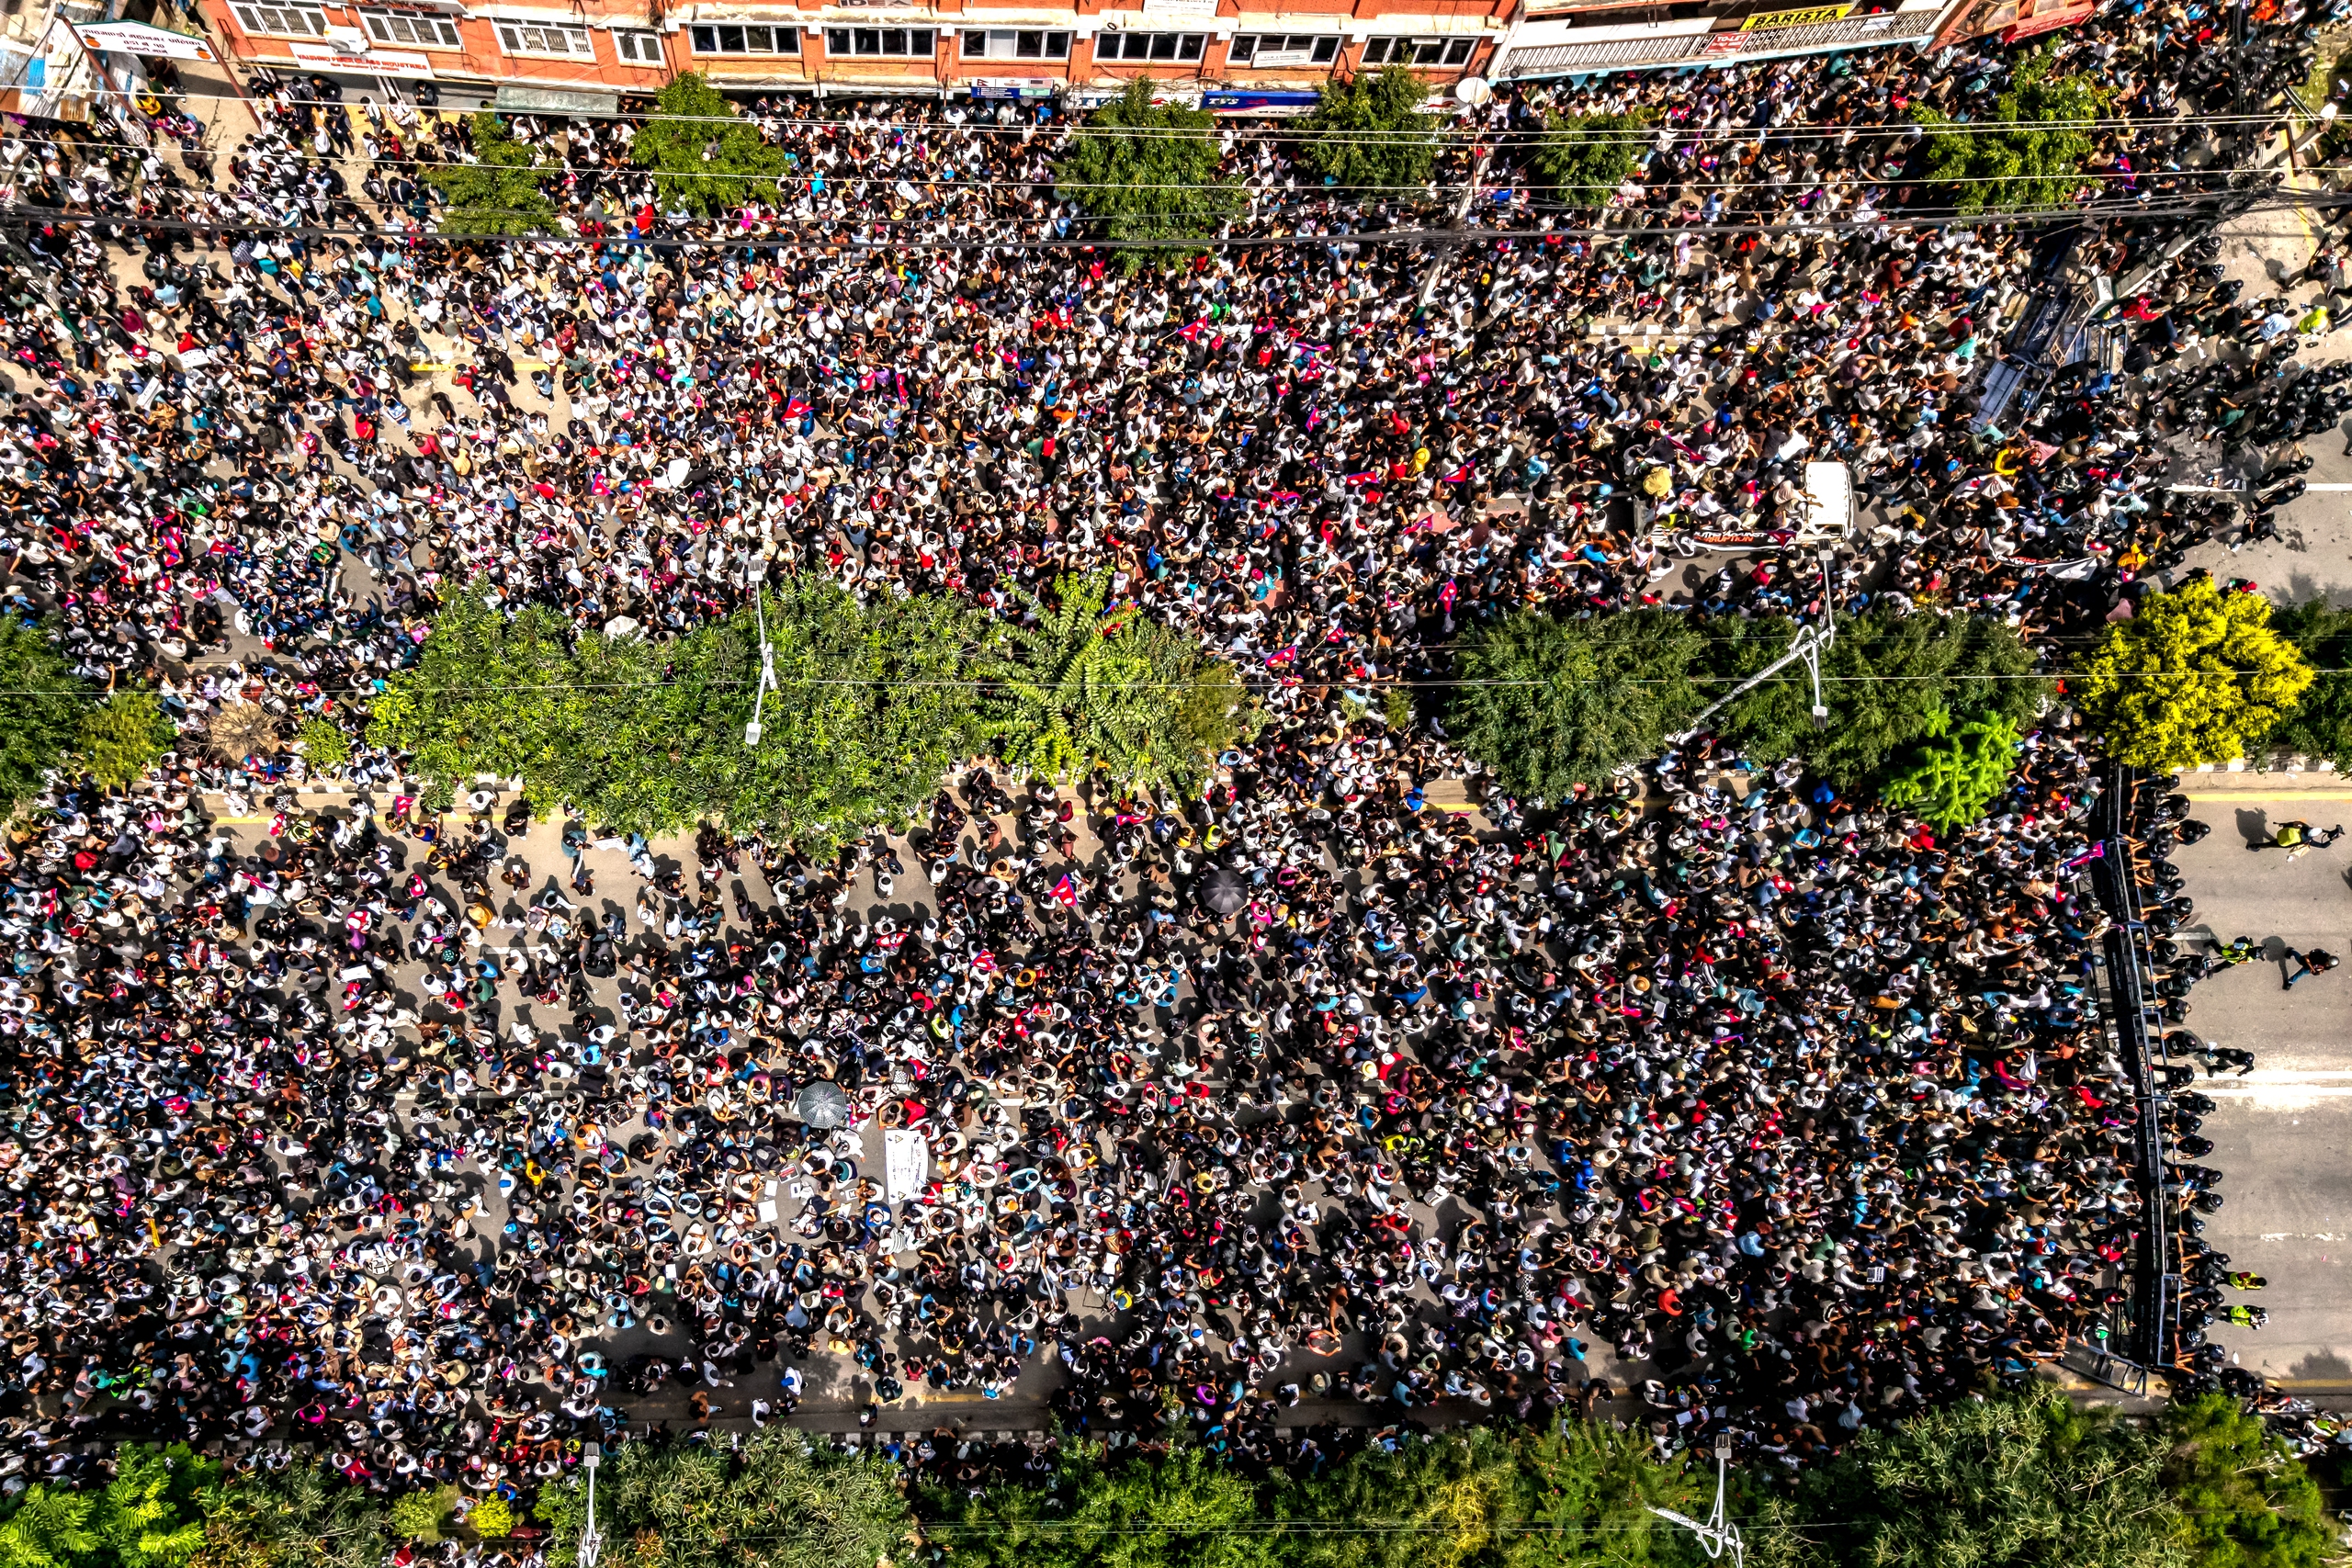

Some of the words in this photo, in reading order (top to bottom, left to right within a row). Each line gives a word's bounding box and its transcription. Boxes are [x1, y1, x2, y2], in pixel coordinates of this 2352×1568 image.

[1753, 8, 1838, 26] BARISTA
[1746, 21, 1790, 30] TRAINING
[355, 57, 381, 66] GLASS
[381, 61, 428, 70] INDUSTRIES
[1724, 530, 1768, 538] AGAINST
